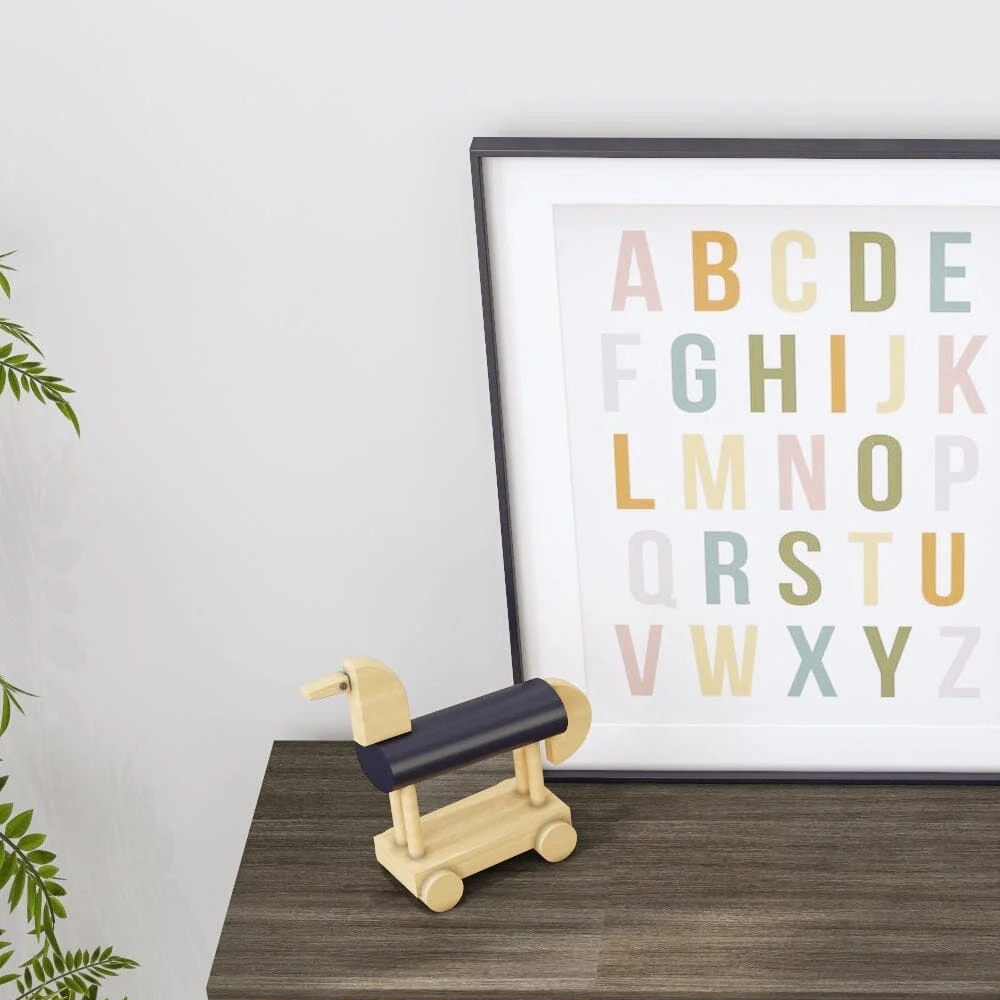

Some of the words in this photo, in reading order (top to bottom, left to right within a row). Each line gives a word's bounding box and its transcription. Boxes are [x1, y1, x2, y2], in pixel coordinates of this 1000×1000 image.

[611, 230, 663, 311] A
[691, 230, 740, 312] B
[770, 230, 817, 313] C
[849, 231, 897, 312] D
[929, 231, 971, 312] E
[601, 333, 641, 412] F
[670, 333, 716, 413] G
[748, 334, 797, 413] H
[830, 334, 846, 413] I
[876, 334, 905, 414] J
[938, 334, 988, 414] K
[613, 434, 655, 509] L
[682, 434, 745, 510] M
[777, 434, 826, 511] N
[857, 434, 902, 511] O
[934, 435, 980, 511] P
[628, 530, 677, 609] Q
[704, 531, 750, 605] R
[778, 531, 822, 606] S
[849, 532, 893, 606] T
[921, 532, 965, 607] U
[614, 625, 663, 696] V
[690, 625, 758, 697] W
[787, 626, 838, 697] X
[862, 626, 912, 698] Y
[938, 626, 982, 698] Z
